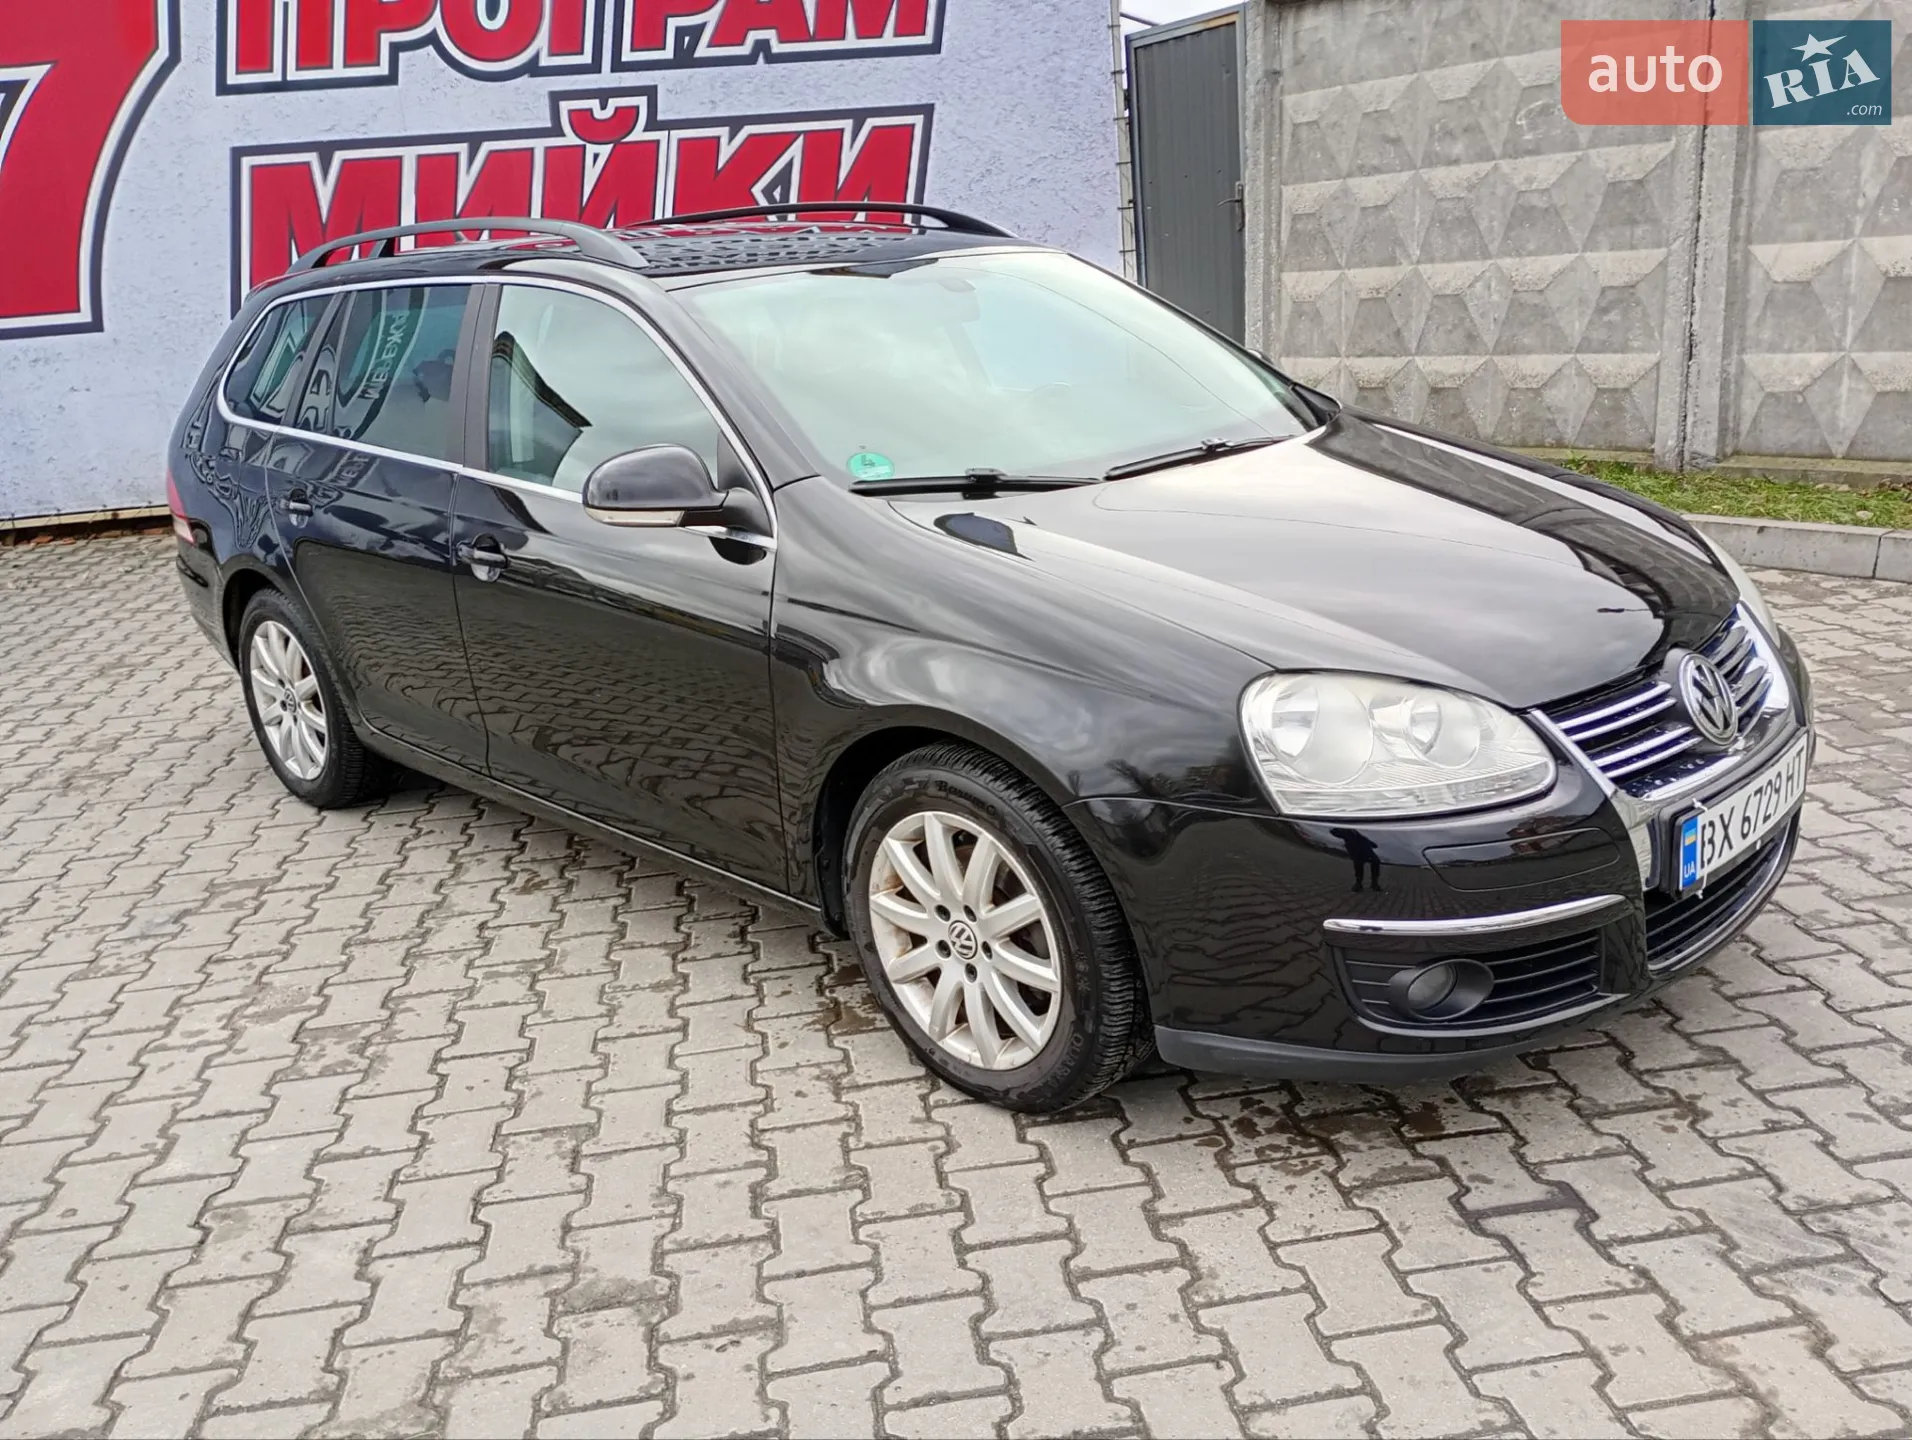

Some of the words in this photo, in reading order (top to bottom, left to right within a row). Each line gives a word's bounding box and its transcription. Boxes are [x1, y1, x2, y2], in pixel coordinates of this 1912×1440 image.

[235, 92, 928, 304] МИЙКИ
[1700, 805, 1735, 869] BX
[1741, 770, 1782, 841] 6729
[1785, 745, 1804, 804] HT
[1683, 863, 1696, 878] UA
